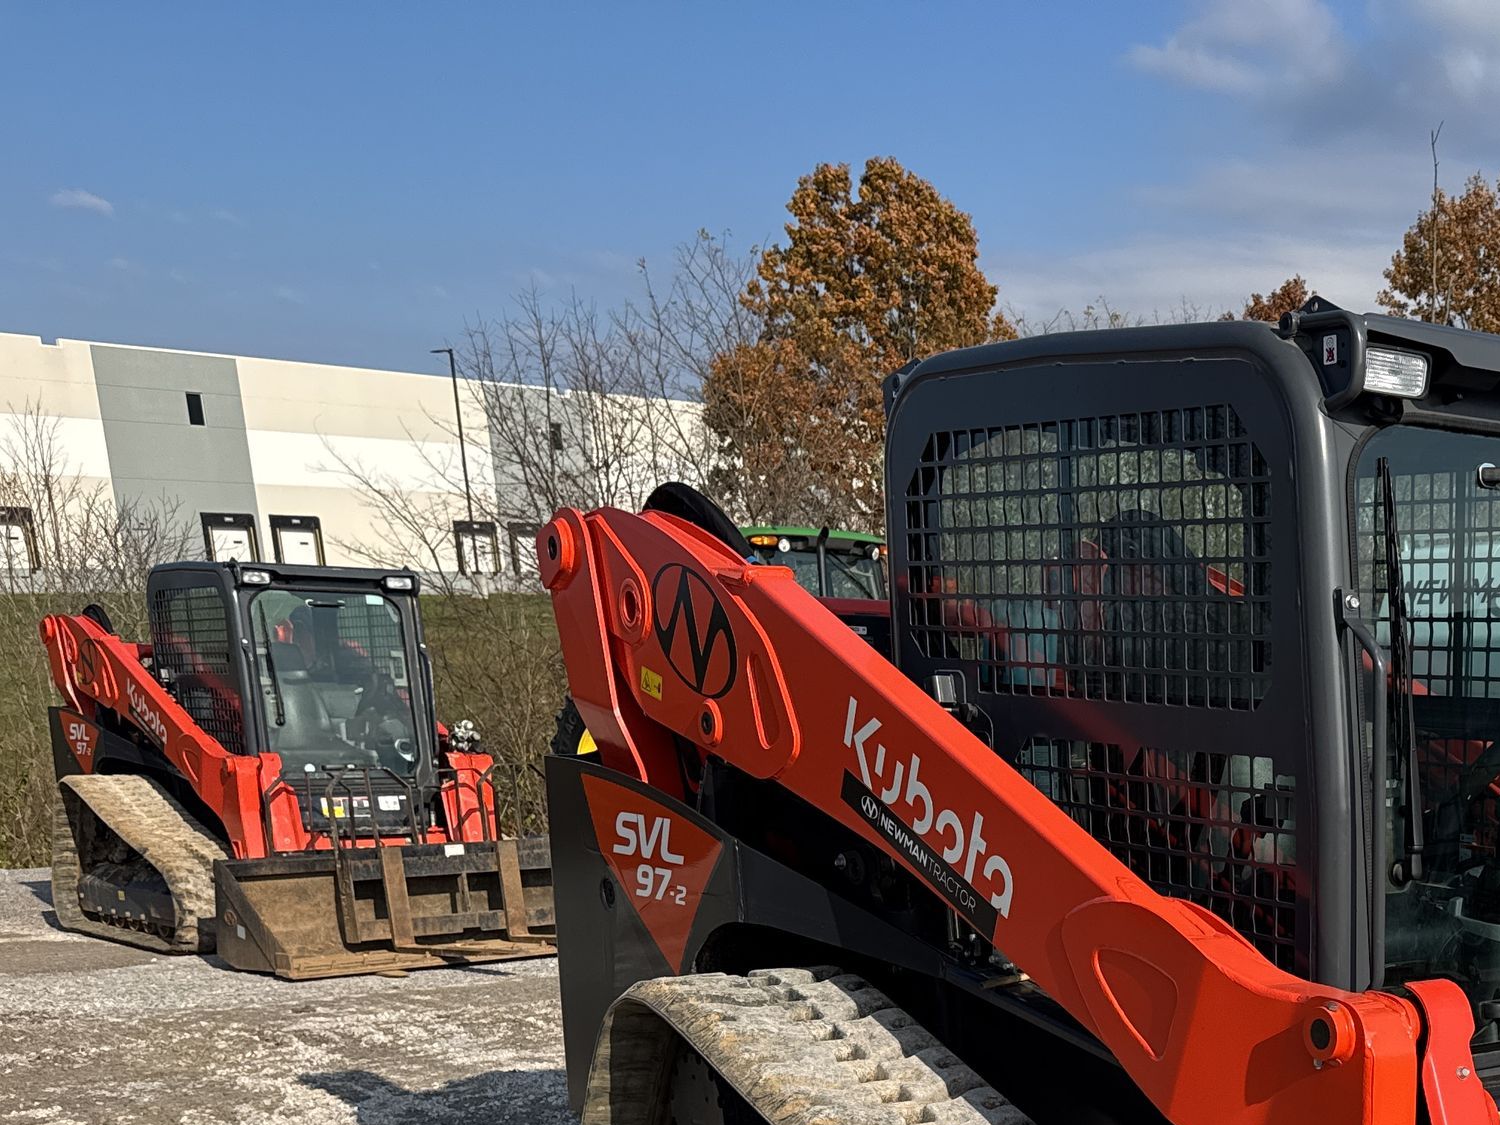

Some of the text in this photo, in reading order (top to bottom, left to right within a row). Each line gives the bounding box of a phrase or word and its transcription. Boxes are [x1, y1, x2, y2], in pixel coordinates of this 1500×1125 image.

[69, 723, 90, 741] SVL
[127, 678, 168, 745] Kubota
[843, 696, 1014, 919] Kubota
[613, 811, 685, 866] SVL
[636, 864, 687, 906] 97-2
